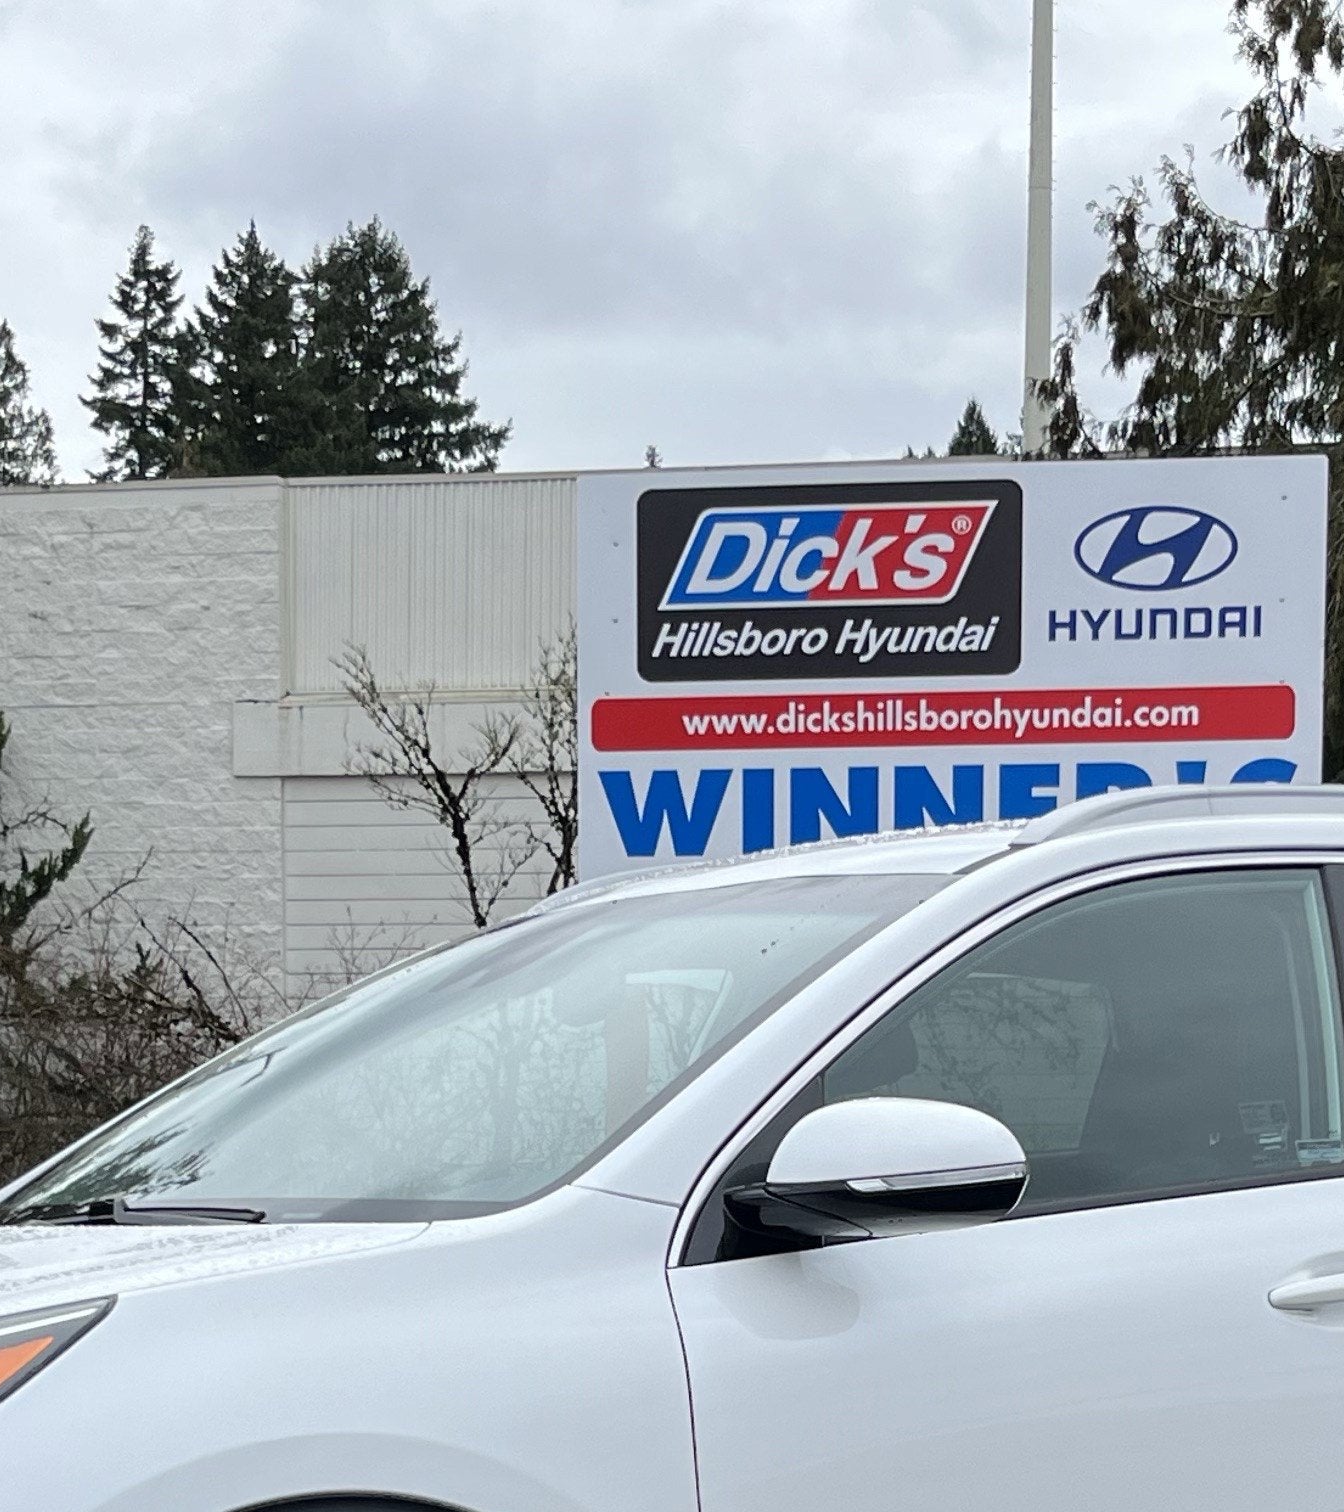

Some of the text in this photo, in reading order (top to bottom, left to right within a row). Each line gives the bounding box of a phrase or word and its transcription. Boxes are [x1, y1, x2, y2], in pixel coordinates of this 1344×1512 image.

[685, 514, 953, 597] Dick's
[652, 615, 1000, 664] Hillsboro Hyundai
[1048, 605, 1262, 642] HYUNDAI
[681, 696, 1200, 738] www.dickshillsborohyundai.com
